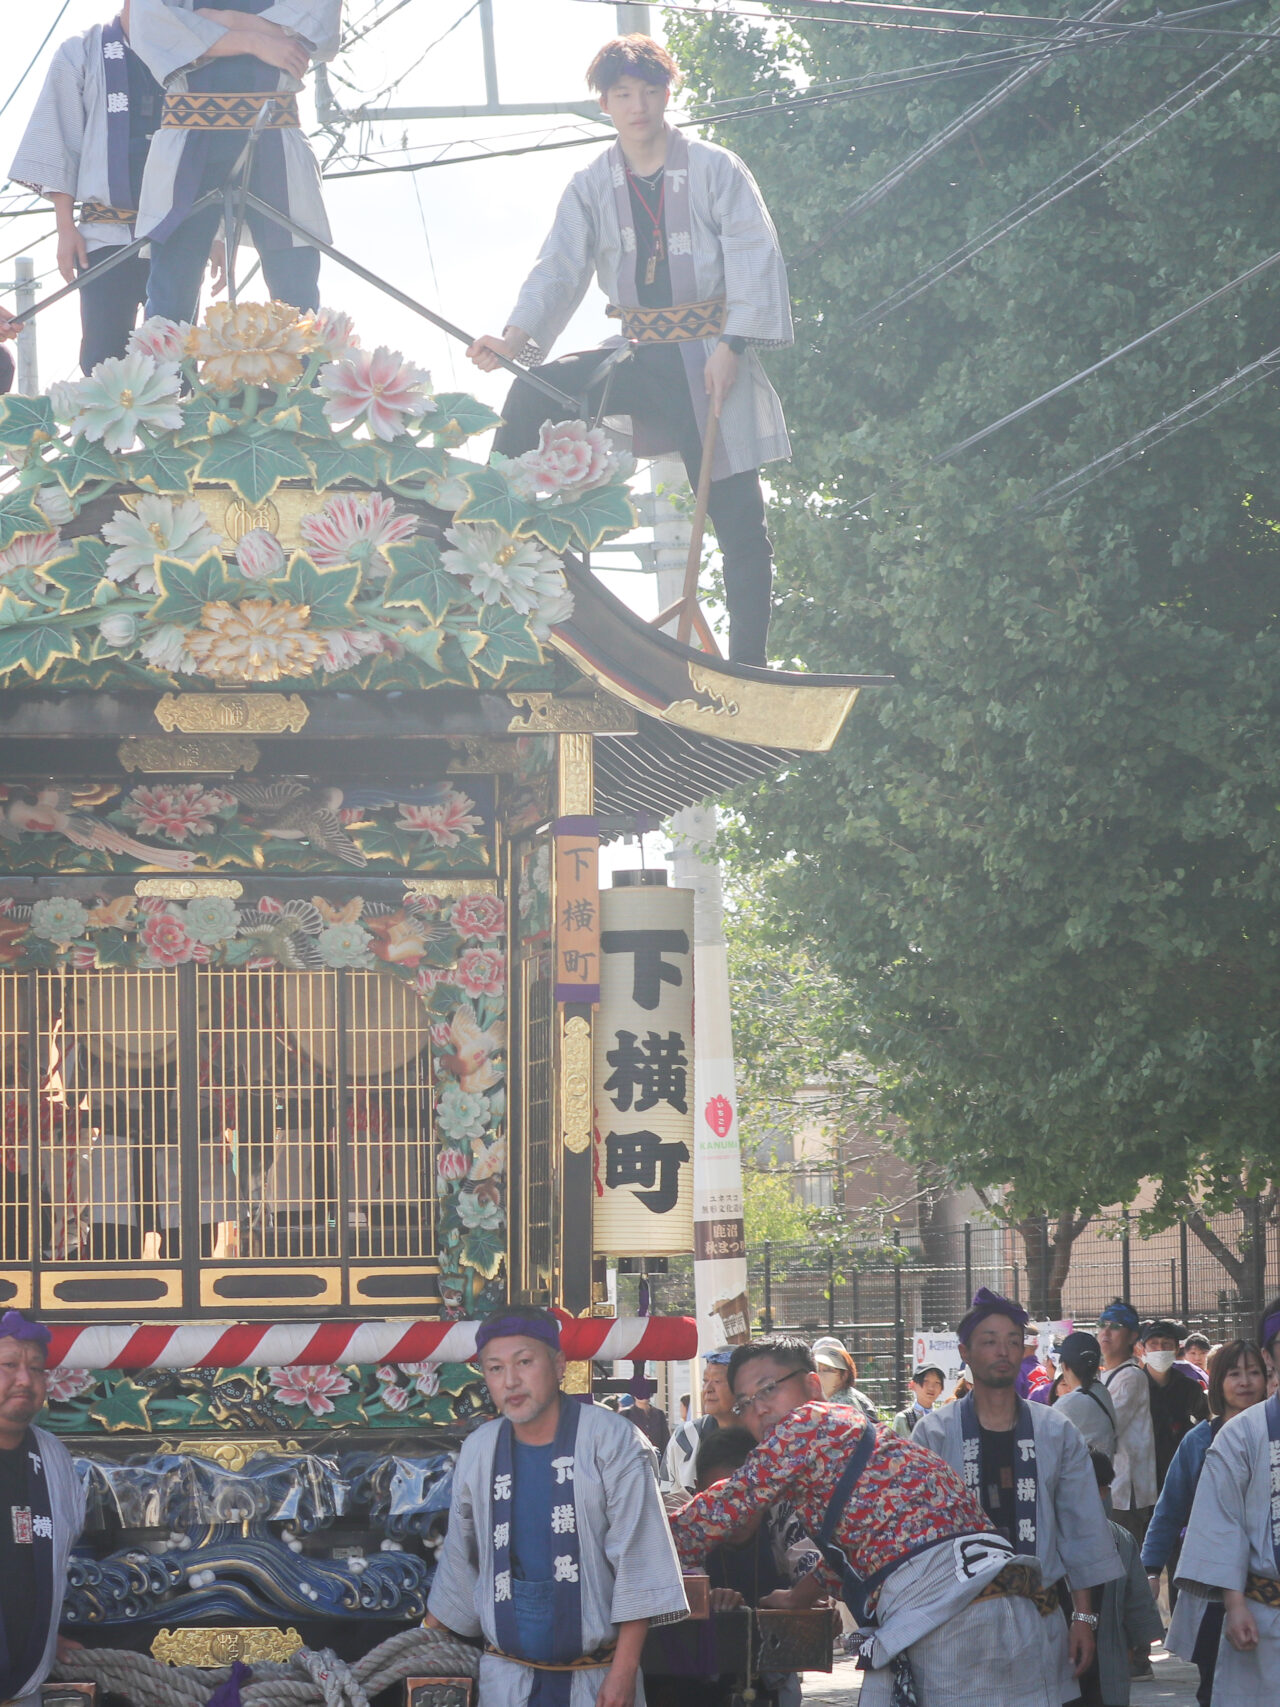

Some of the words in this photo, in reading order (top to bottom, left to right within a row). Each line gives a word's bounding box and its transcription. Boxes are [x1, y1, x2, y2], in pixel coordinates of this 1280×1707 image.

[666, 168, 692, 256] 下横
[561, 847, 596, 982] 下横町
[600, 928, 691, 1214] 下横町
[713, 1223, 738, 1239] 鹿沼
